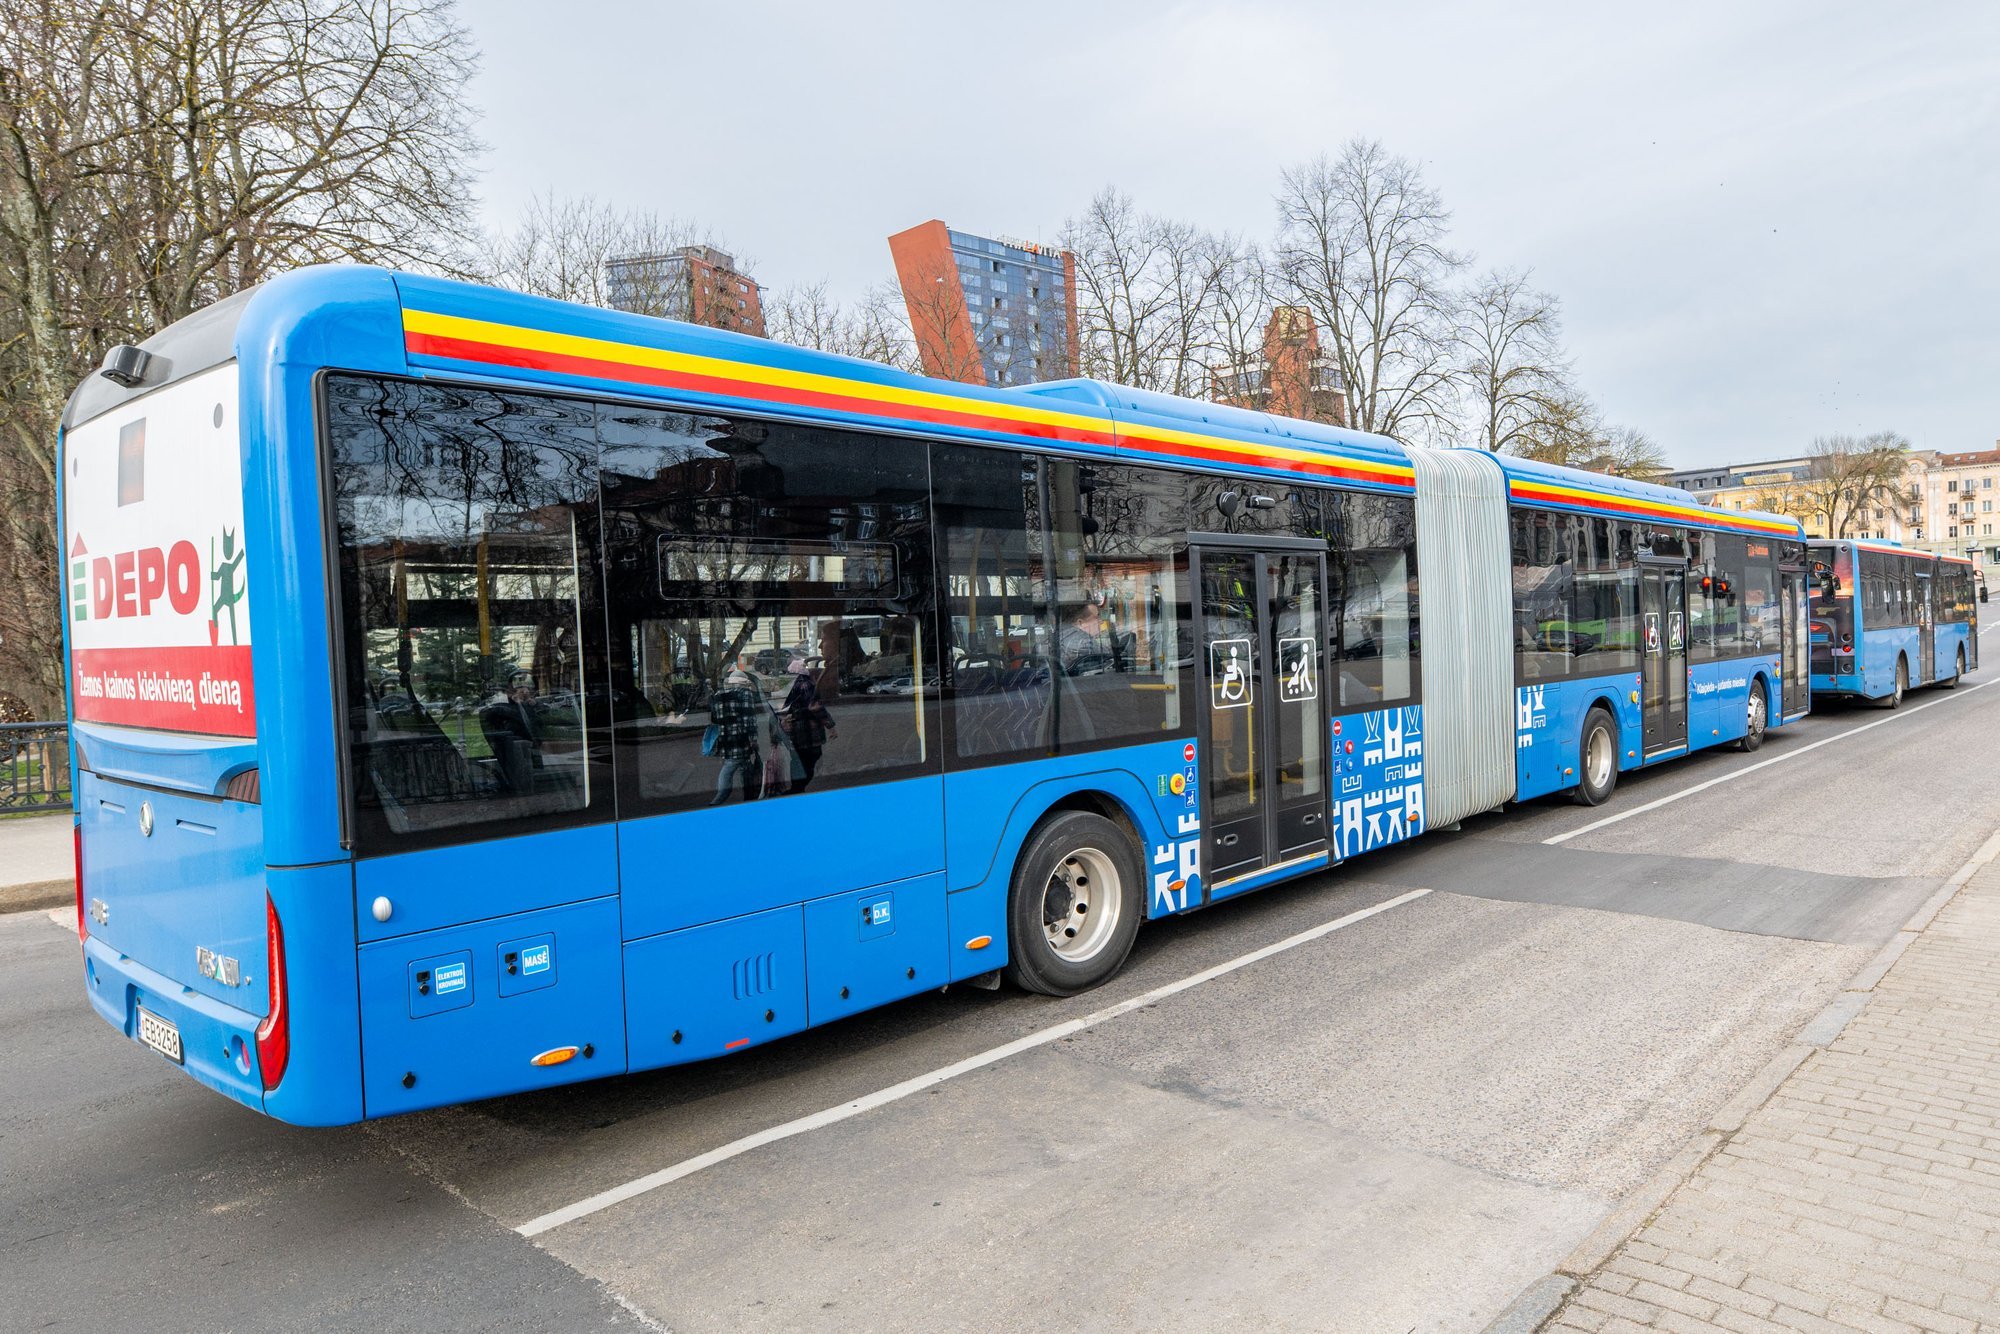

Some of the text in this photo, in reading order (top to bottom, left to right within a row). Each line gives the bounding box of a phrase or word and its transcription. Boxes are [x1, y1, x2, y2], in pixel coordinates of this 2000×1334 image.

[93, 540, 201, 620] DEPO
[78, 663, 243, 713] Žemos kainos kiekvieną dieną
[525, 951, 547, 967] MASĖ
[145, 1017, 178, 1055] EB3258
